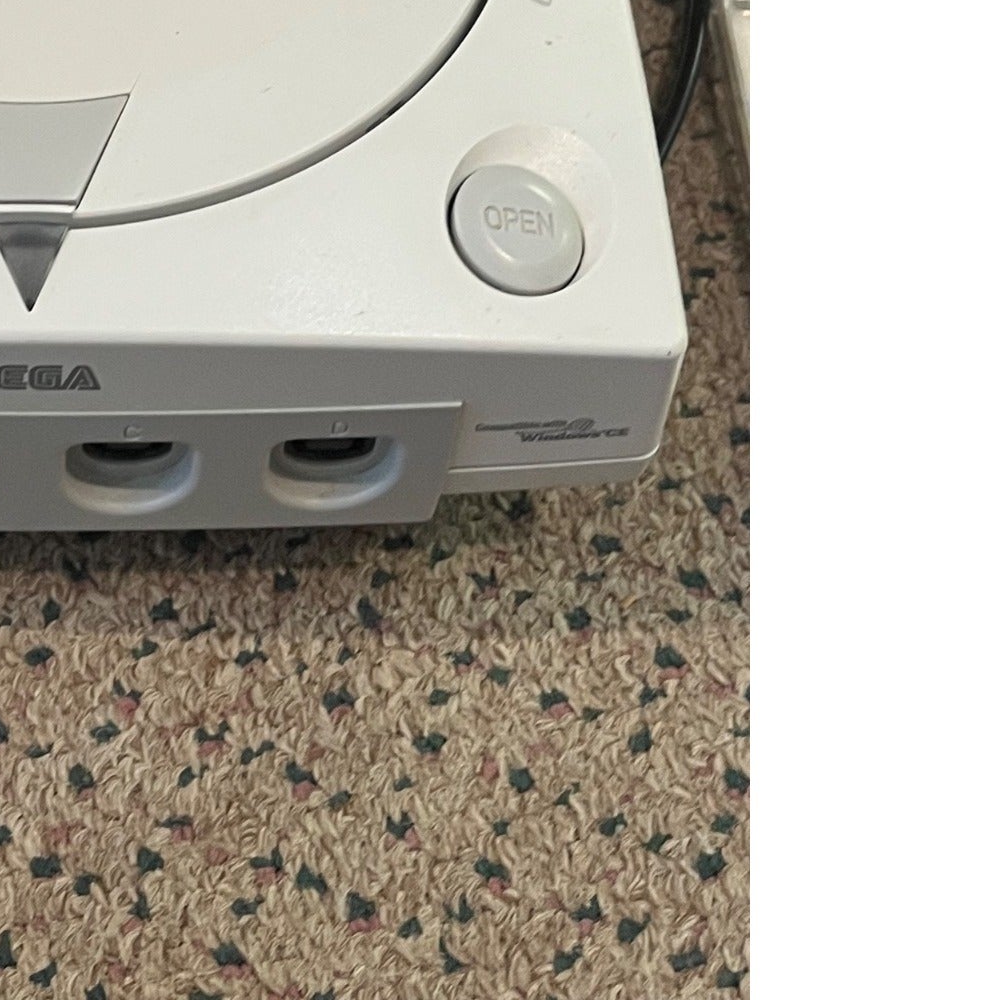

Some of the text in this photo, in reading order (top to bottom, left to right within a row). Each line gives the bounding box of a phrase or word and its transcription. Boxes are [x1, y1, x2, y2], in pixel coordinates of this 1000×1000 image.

[483, 205, 555, 237] OPEN
[122, 424, 142, 442] C
[330, 420, 349, 437] D
